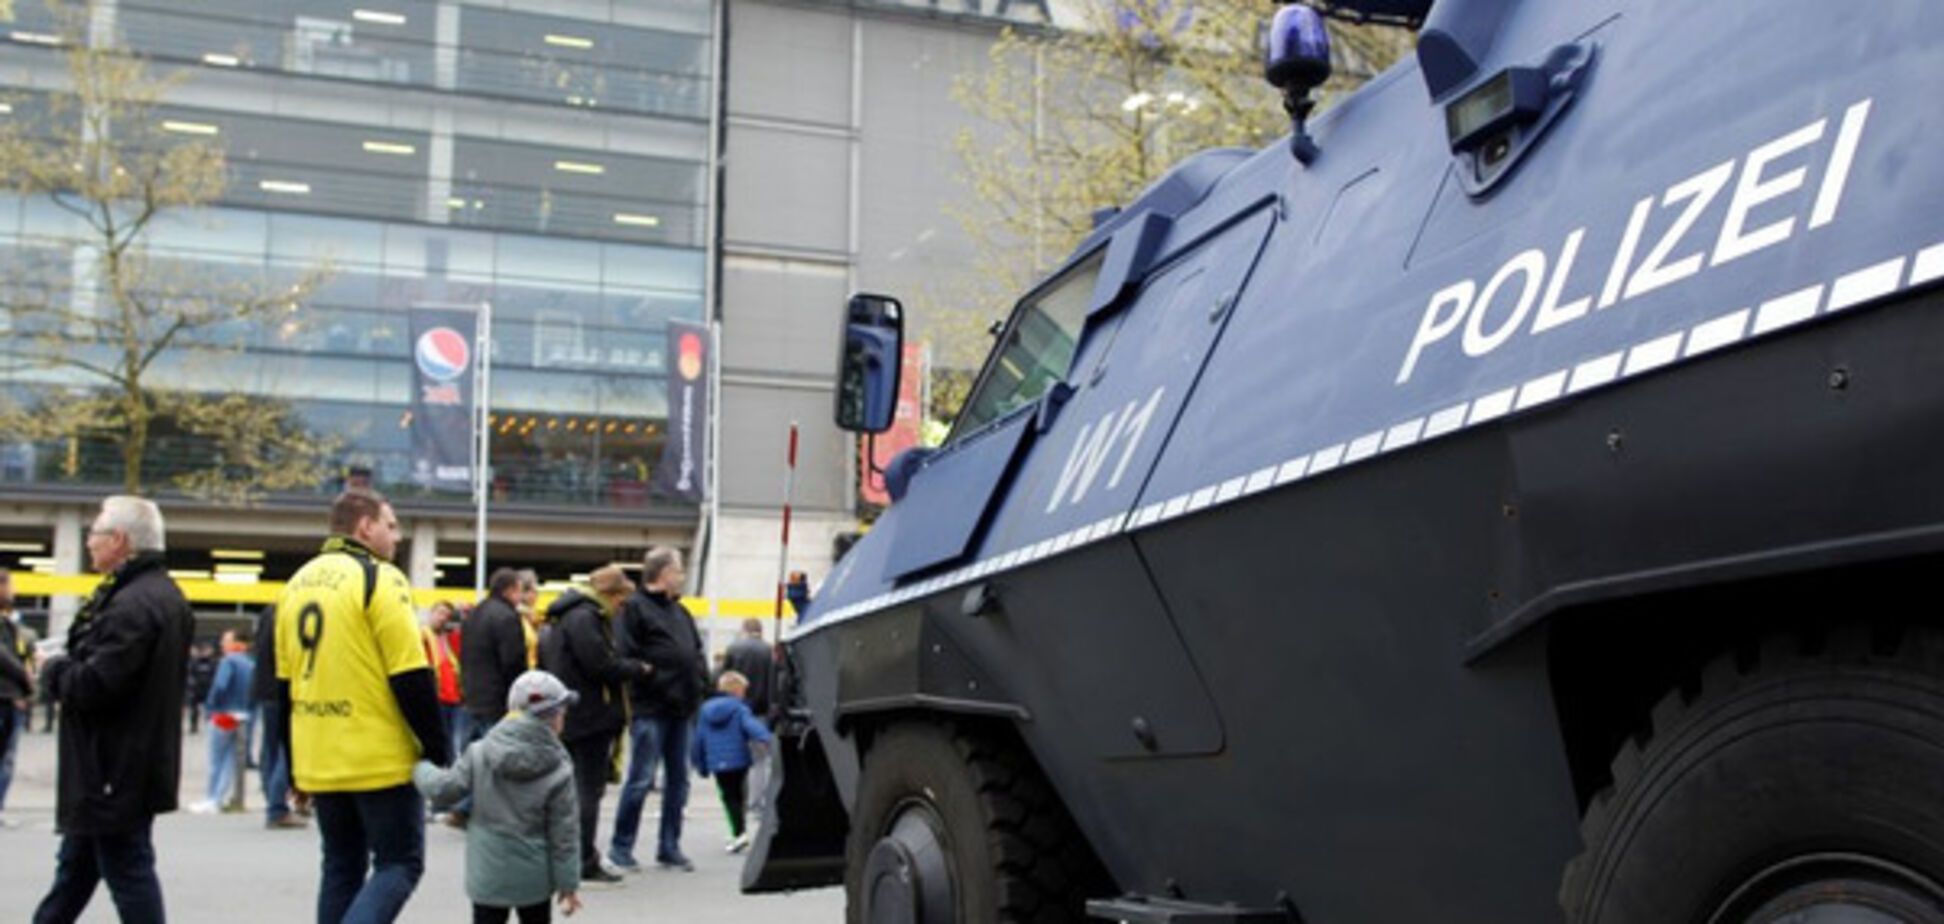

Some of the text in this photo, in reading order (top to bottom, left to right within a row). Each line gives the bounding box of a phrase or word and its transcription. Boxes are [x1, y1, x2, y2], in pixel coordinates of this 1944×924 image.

[1396, 98, 1873, 385] POLIZEI
[1045, 386, 1166, 514] W1
[297, 601, 325, 681] 9
